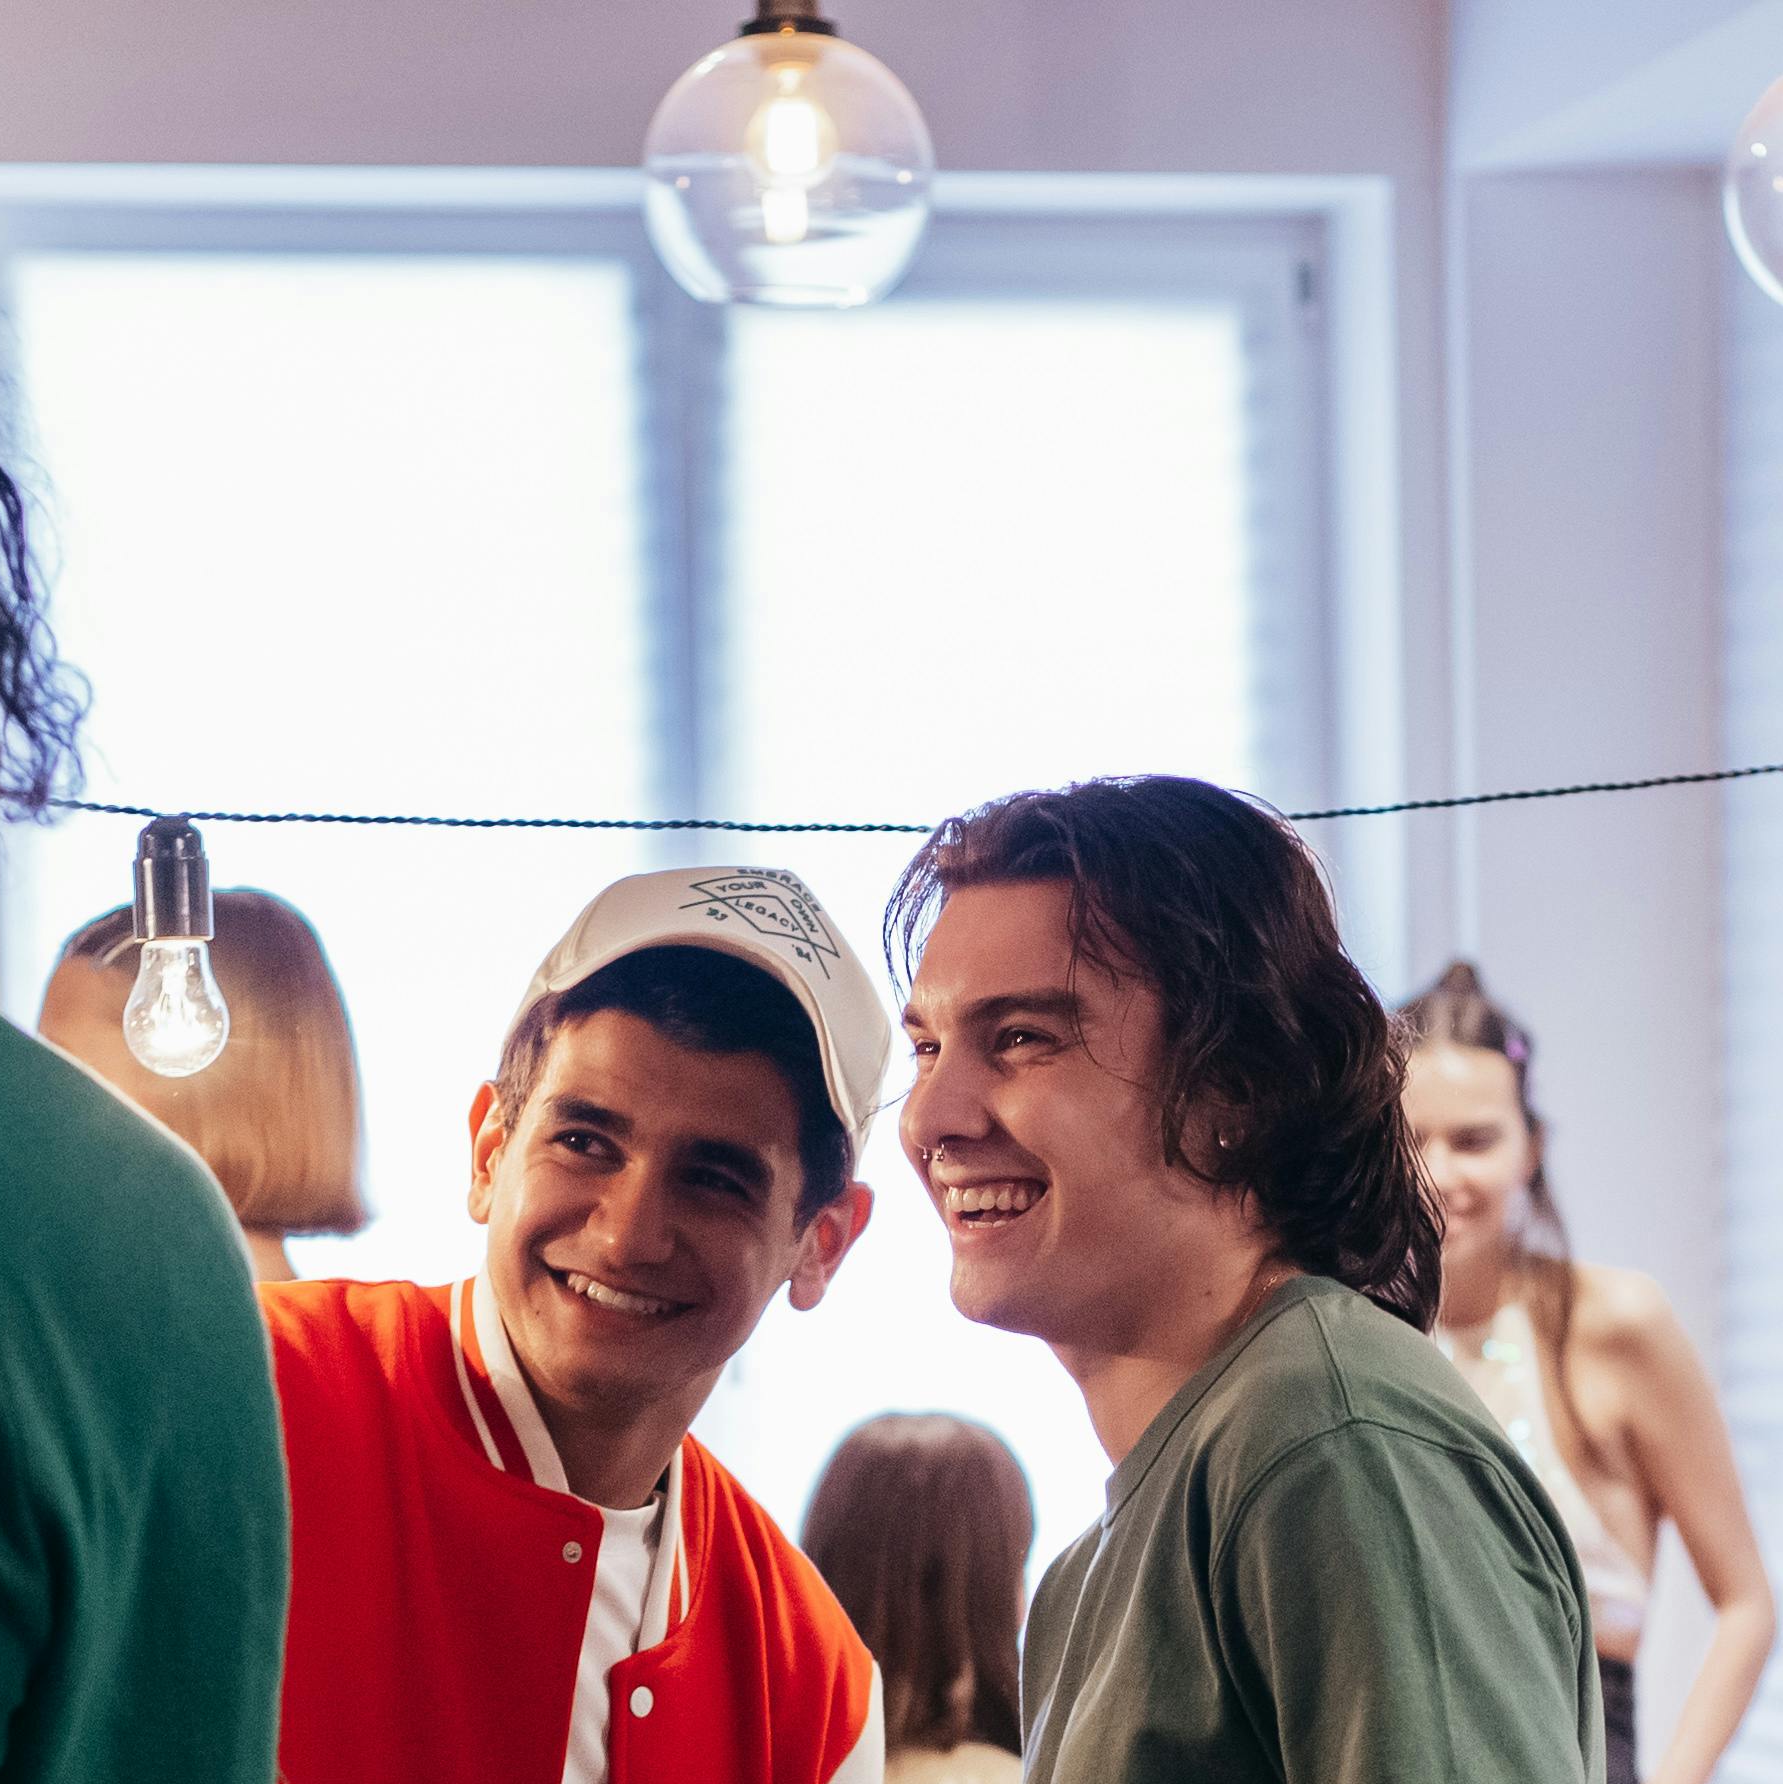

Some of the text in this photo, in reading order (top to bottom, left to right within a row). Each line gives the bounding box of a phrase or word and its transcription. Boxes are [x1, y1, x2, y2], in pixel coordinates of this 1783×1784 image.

[716, 881, 820, 934] YOUR OWN
[736, 868, 822, 912] EMBRACE
[734, 898, 800, 932] LEGACY
